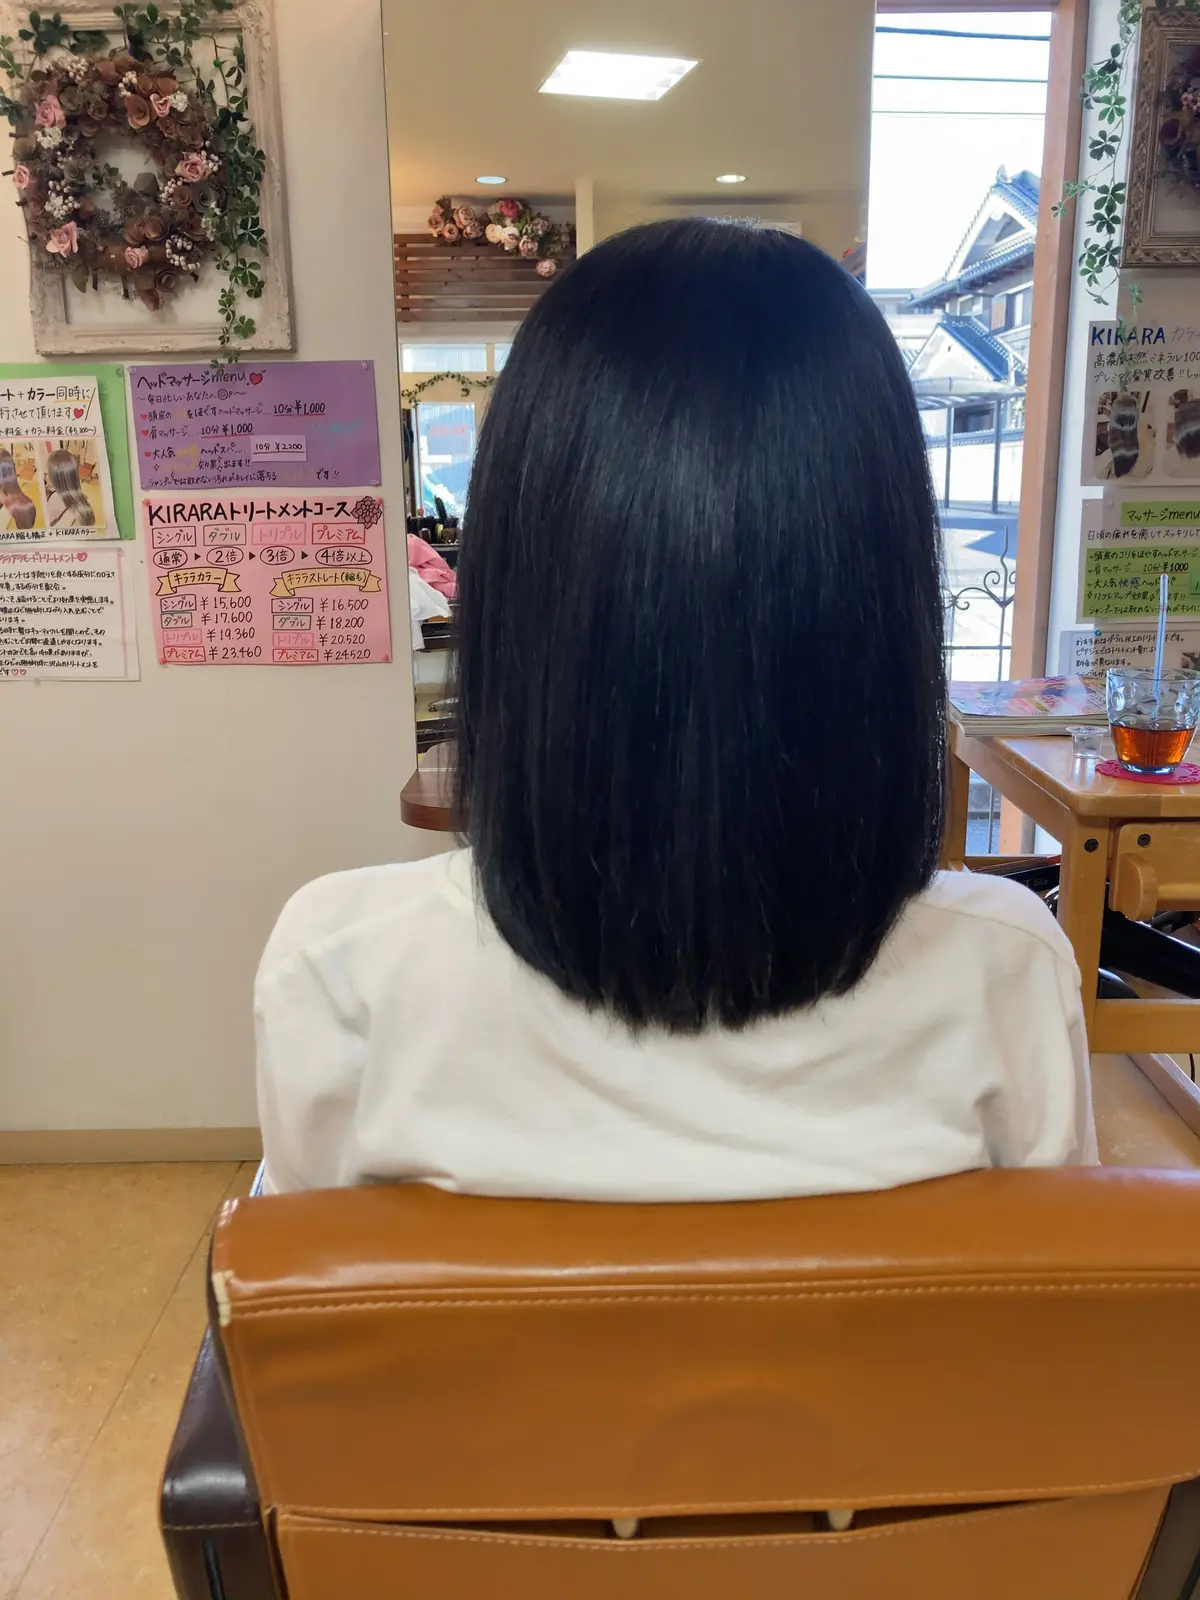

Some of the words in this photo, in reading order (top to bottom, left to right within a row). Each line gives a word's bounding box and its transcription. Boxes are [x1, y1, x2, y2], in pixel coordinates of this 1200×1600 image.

[157, 529, 193, 545] シングル
[208, 527, 241, 543] ダブル
[260, 525, 303, 542] トリプル
[316, 525, 364, 541] プレミアム
[159, 551, 183, 566] 通常
[214, 549, 237, 564] 2倍
[266, 549, 288, 563] 3倍
[320, 549, 368, 564] 4倍以上
[174, 571, 222, 585] キララカラー
[163, 596, 195, 610] シングル
[278, 598, 311, 612] シングル
[164, 613, 190, 627] ダブル
[278, 617, 306, 628] ダブル
[167, 648, 203, 660] プレミアム
[277, 648, 315, 660] プレミアム
